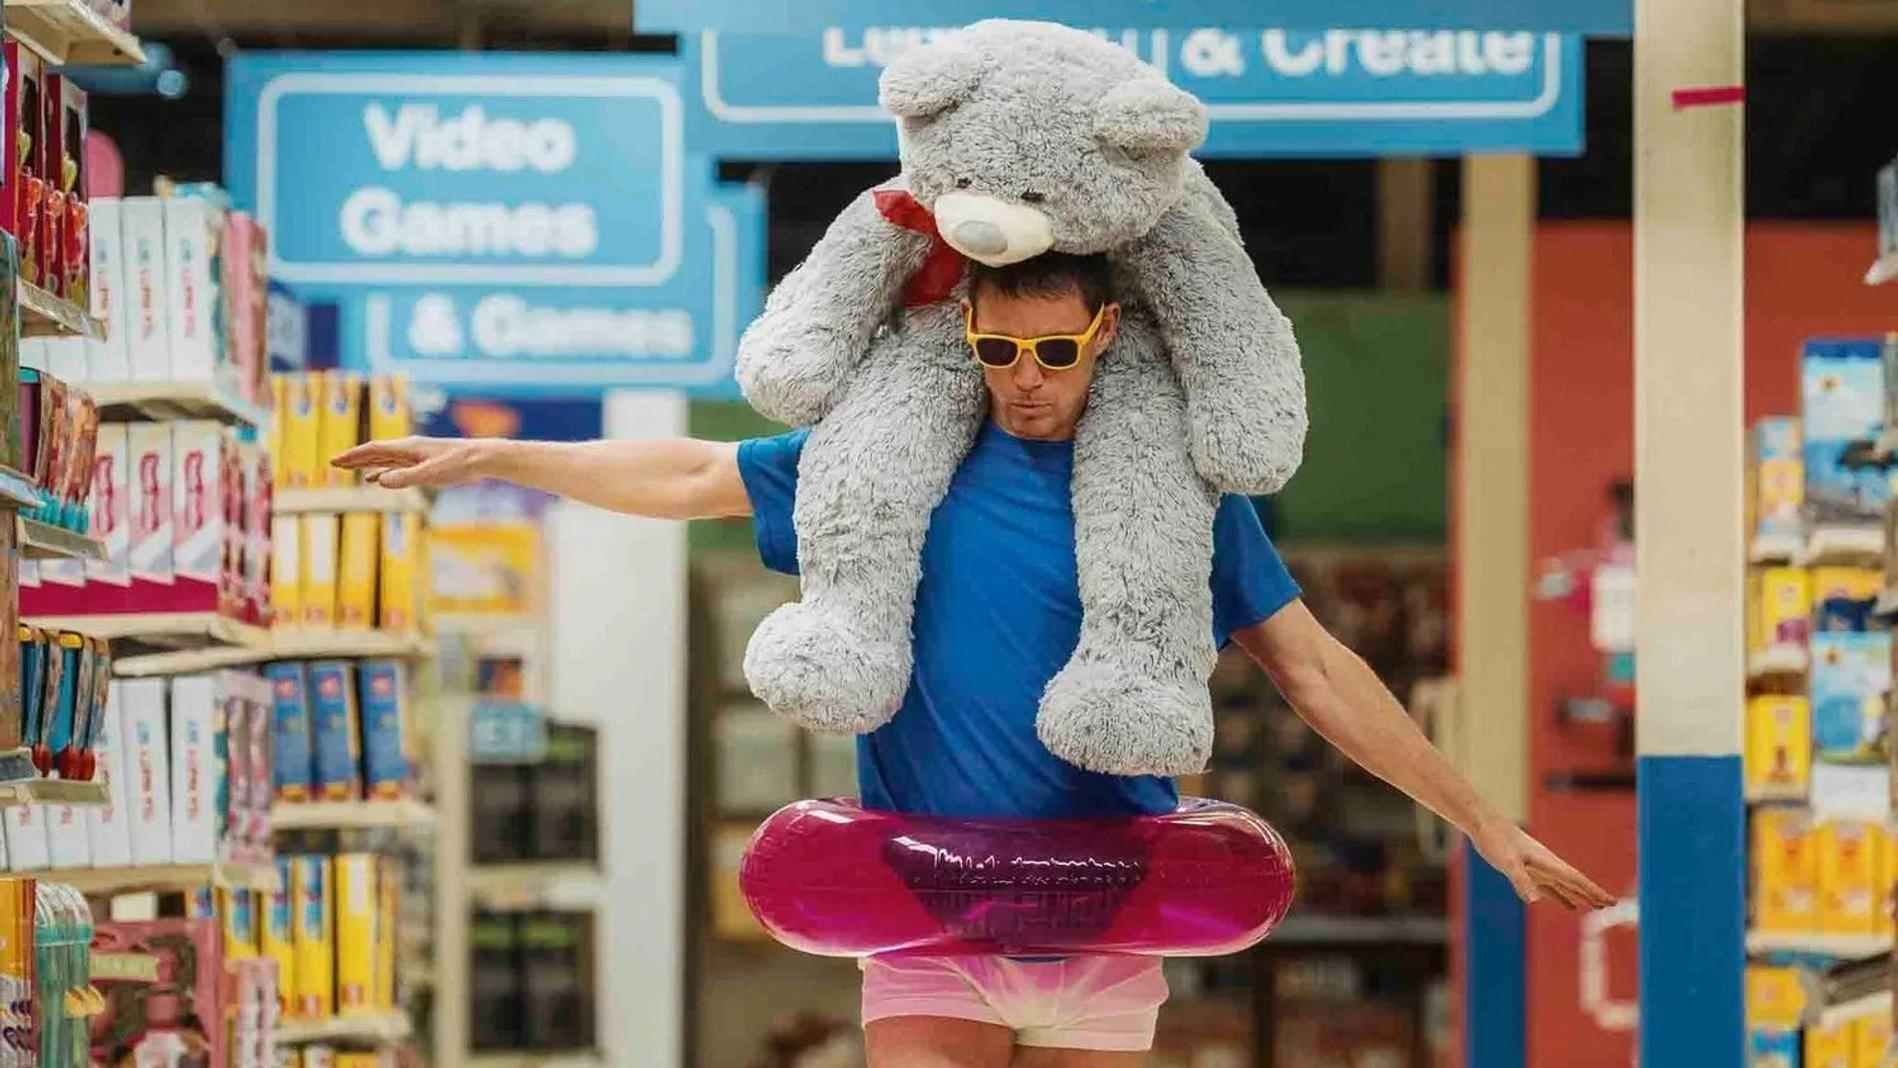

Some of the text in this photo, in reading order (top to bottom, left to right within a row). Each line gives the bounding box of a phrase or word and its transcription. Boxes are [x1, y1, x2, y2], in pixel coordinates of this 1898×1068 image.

[1180, 28, 1246, 77] &
[1262, 28, 1535, 76] Create
[364, 103, 576, 172] Video
[340, 187, 599, 256] Games
[410, 293, 695, 357] & Games
